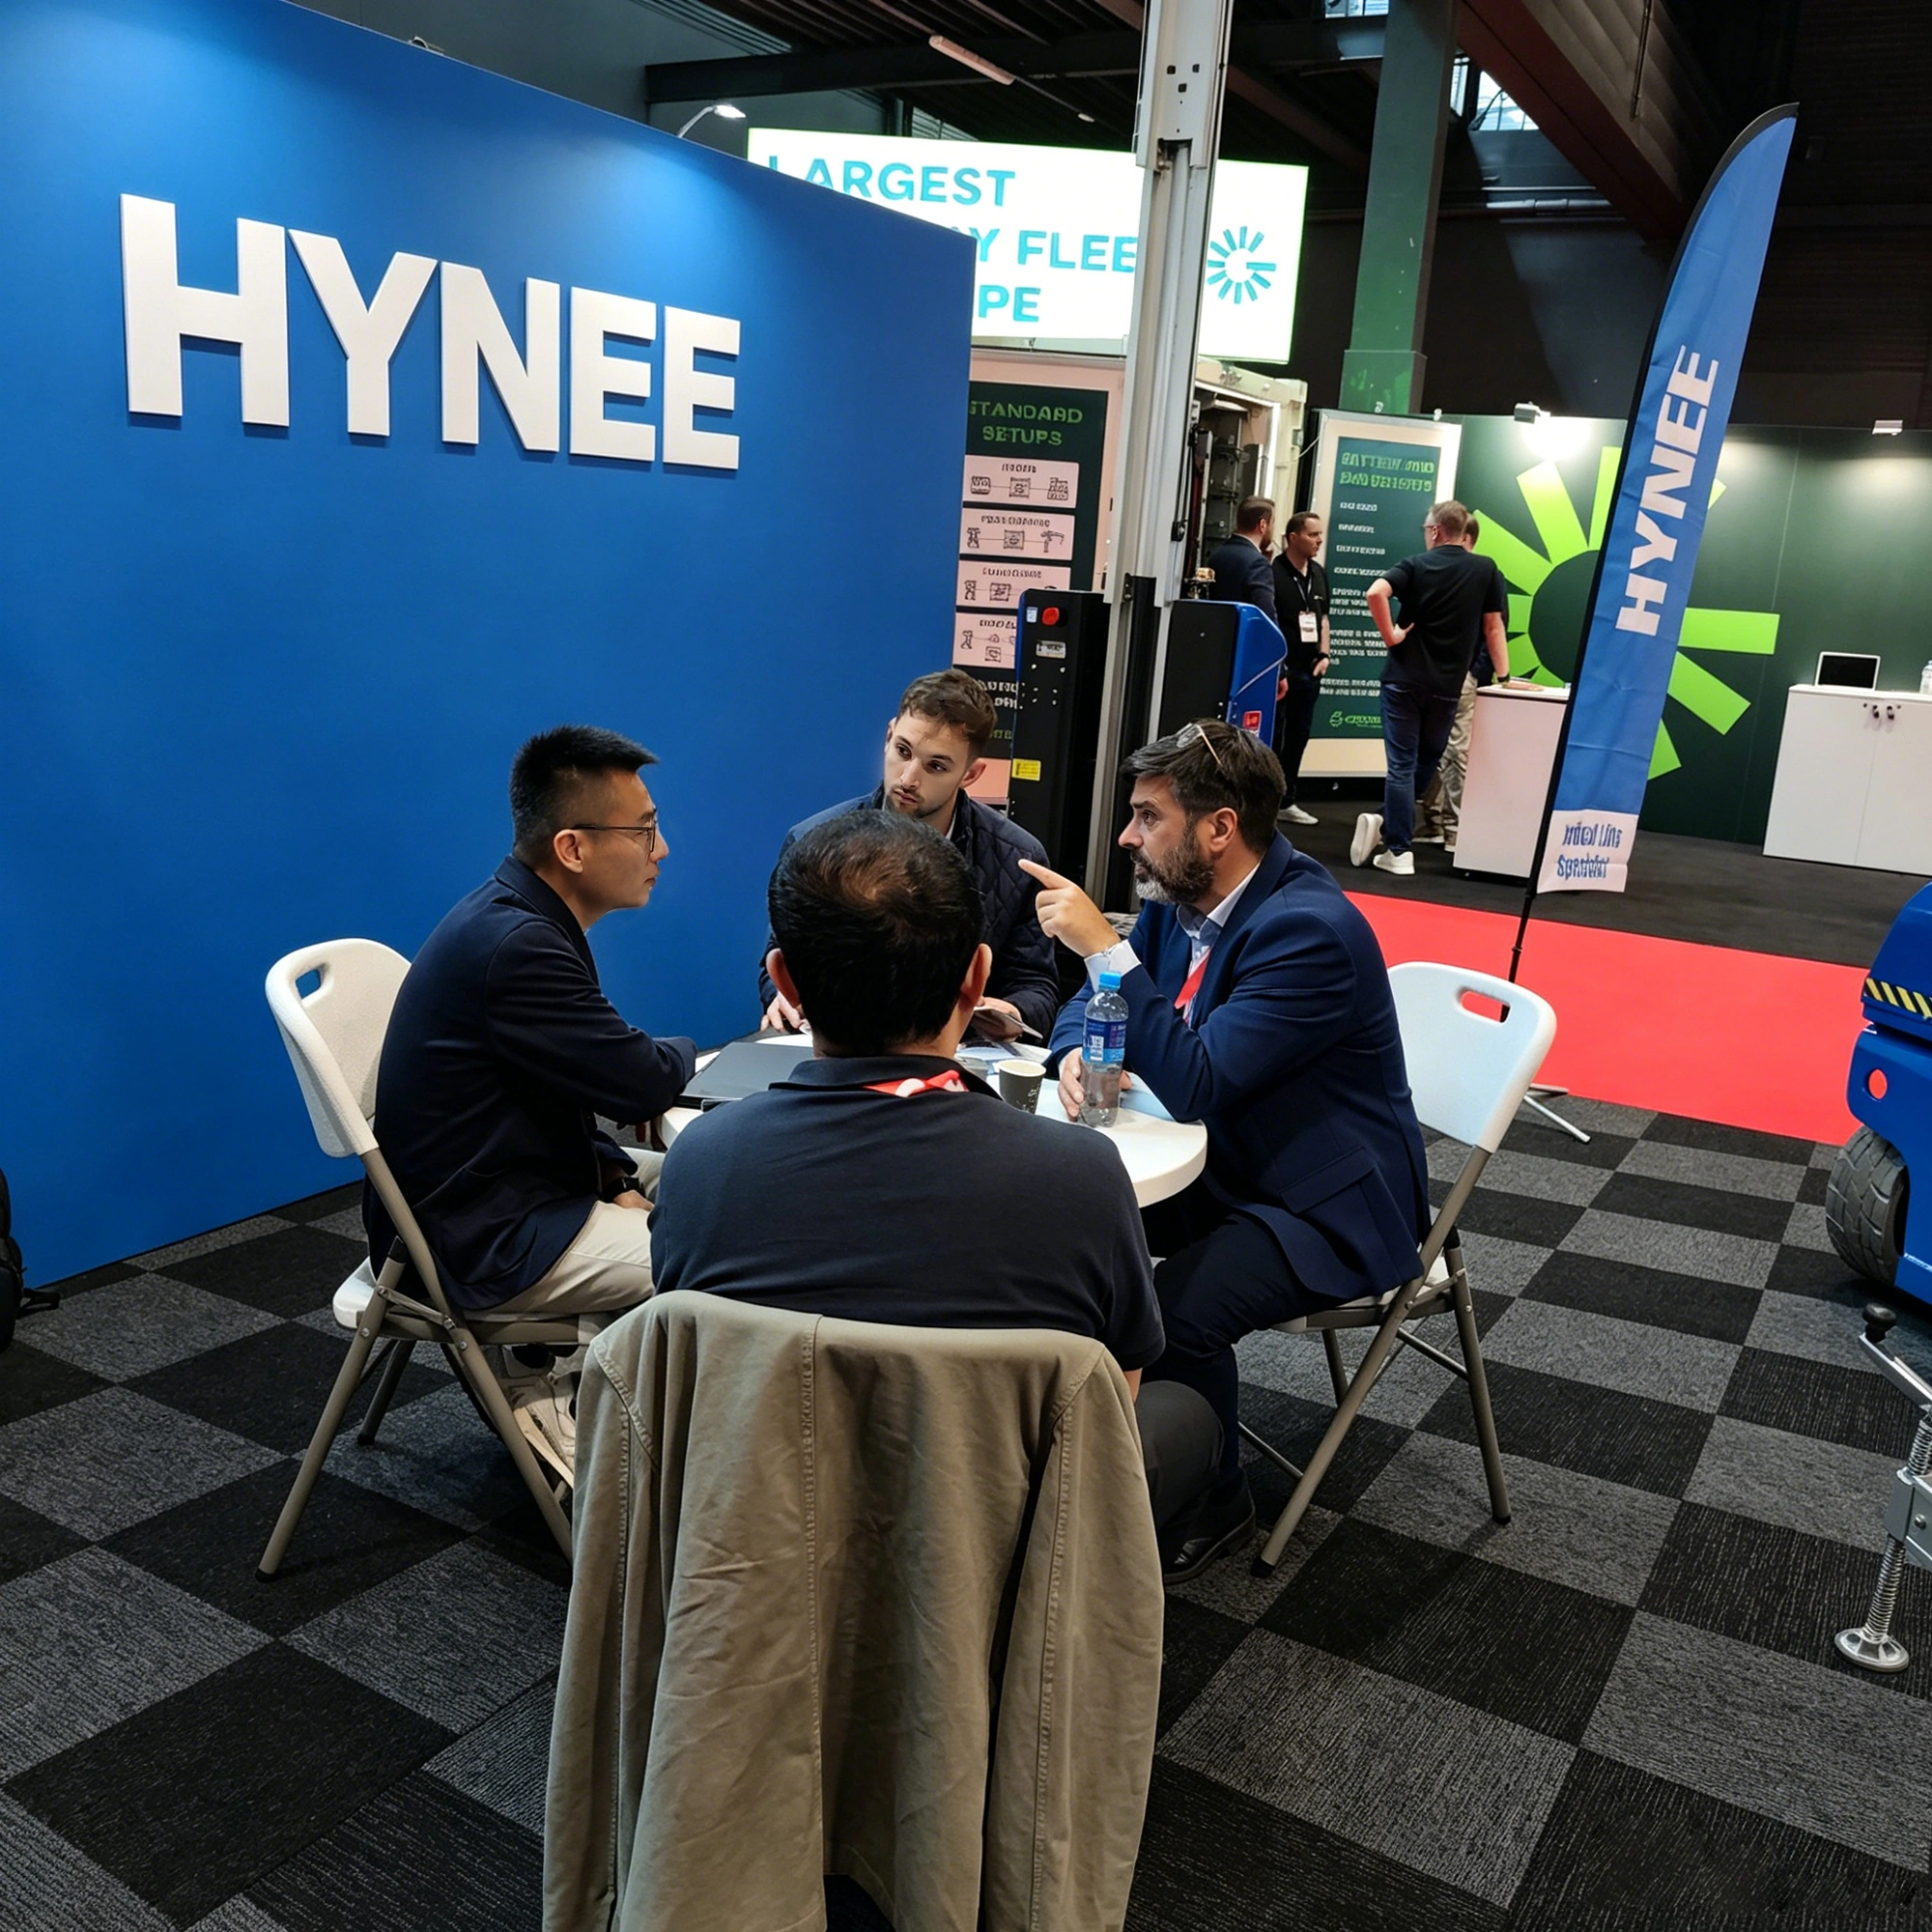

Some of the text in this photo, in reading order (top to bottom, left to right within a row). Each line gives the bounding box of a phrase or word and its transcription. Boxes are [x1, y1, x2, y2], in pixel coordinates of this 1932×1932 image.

[120, 193, 741, 470] HYNEE
[982, 425, 1063, 446] SETUPS
[1615, 344, 1719, 638] HYNEE
